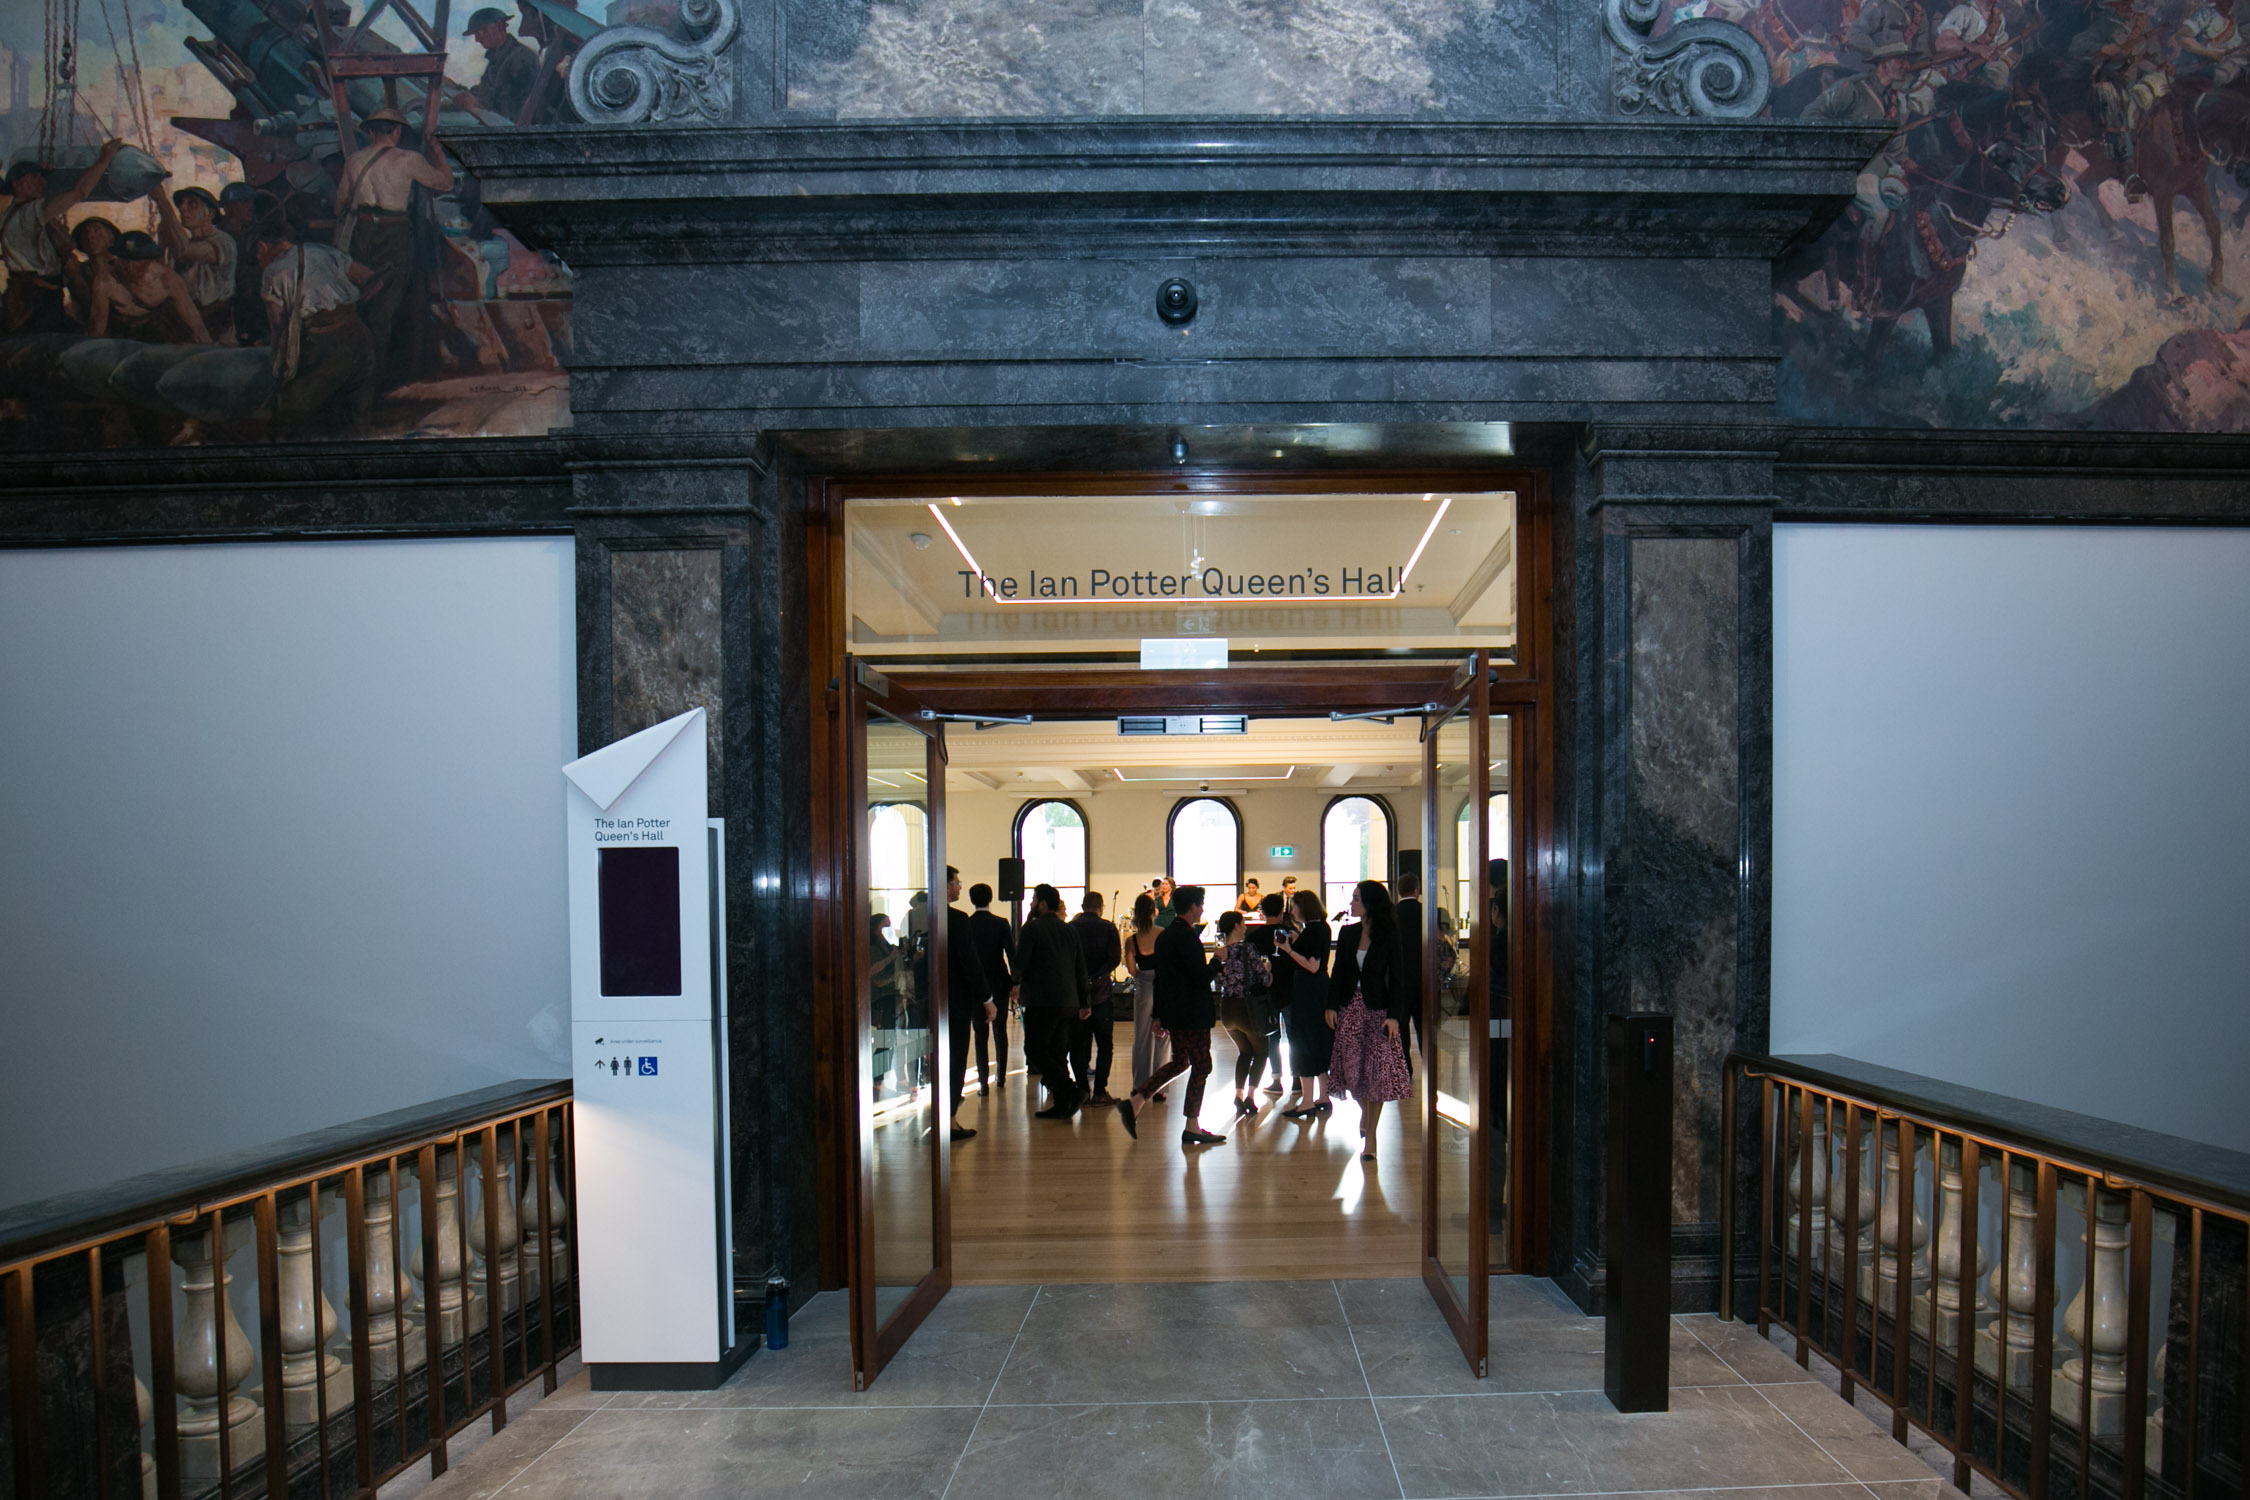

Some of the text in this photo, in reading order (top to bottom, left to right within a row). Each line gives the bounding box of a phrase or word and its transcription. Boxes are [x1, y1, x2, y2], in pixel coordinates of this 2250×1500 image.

[957, 566, 1406, 598] The Ian Potter Queen’s Hall
[594, 817, 671, 829] The Ian Potter
[594, 830, 664, 842] Queen's Hall
